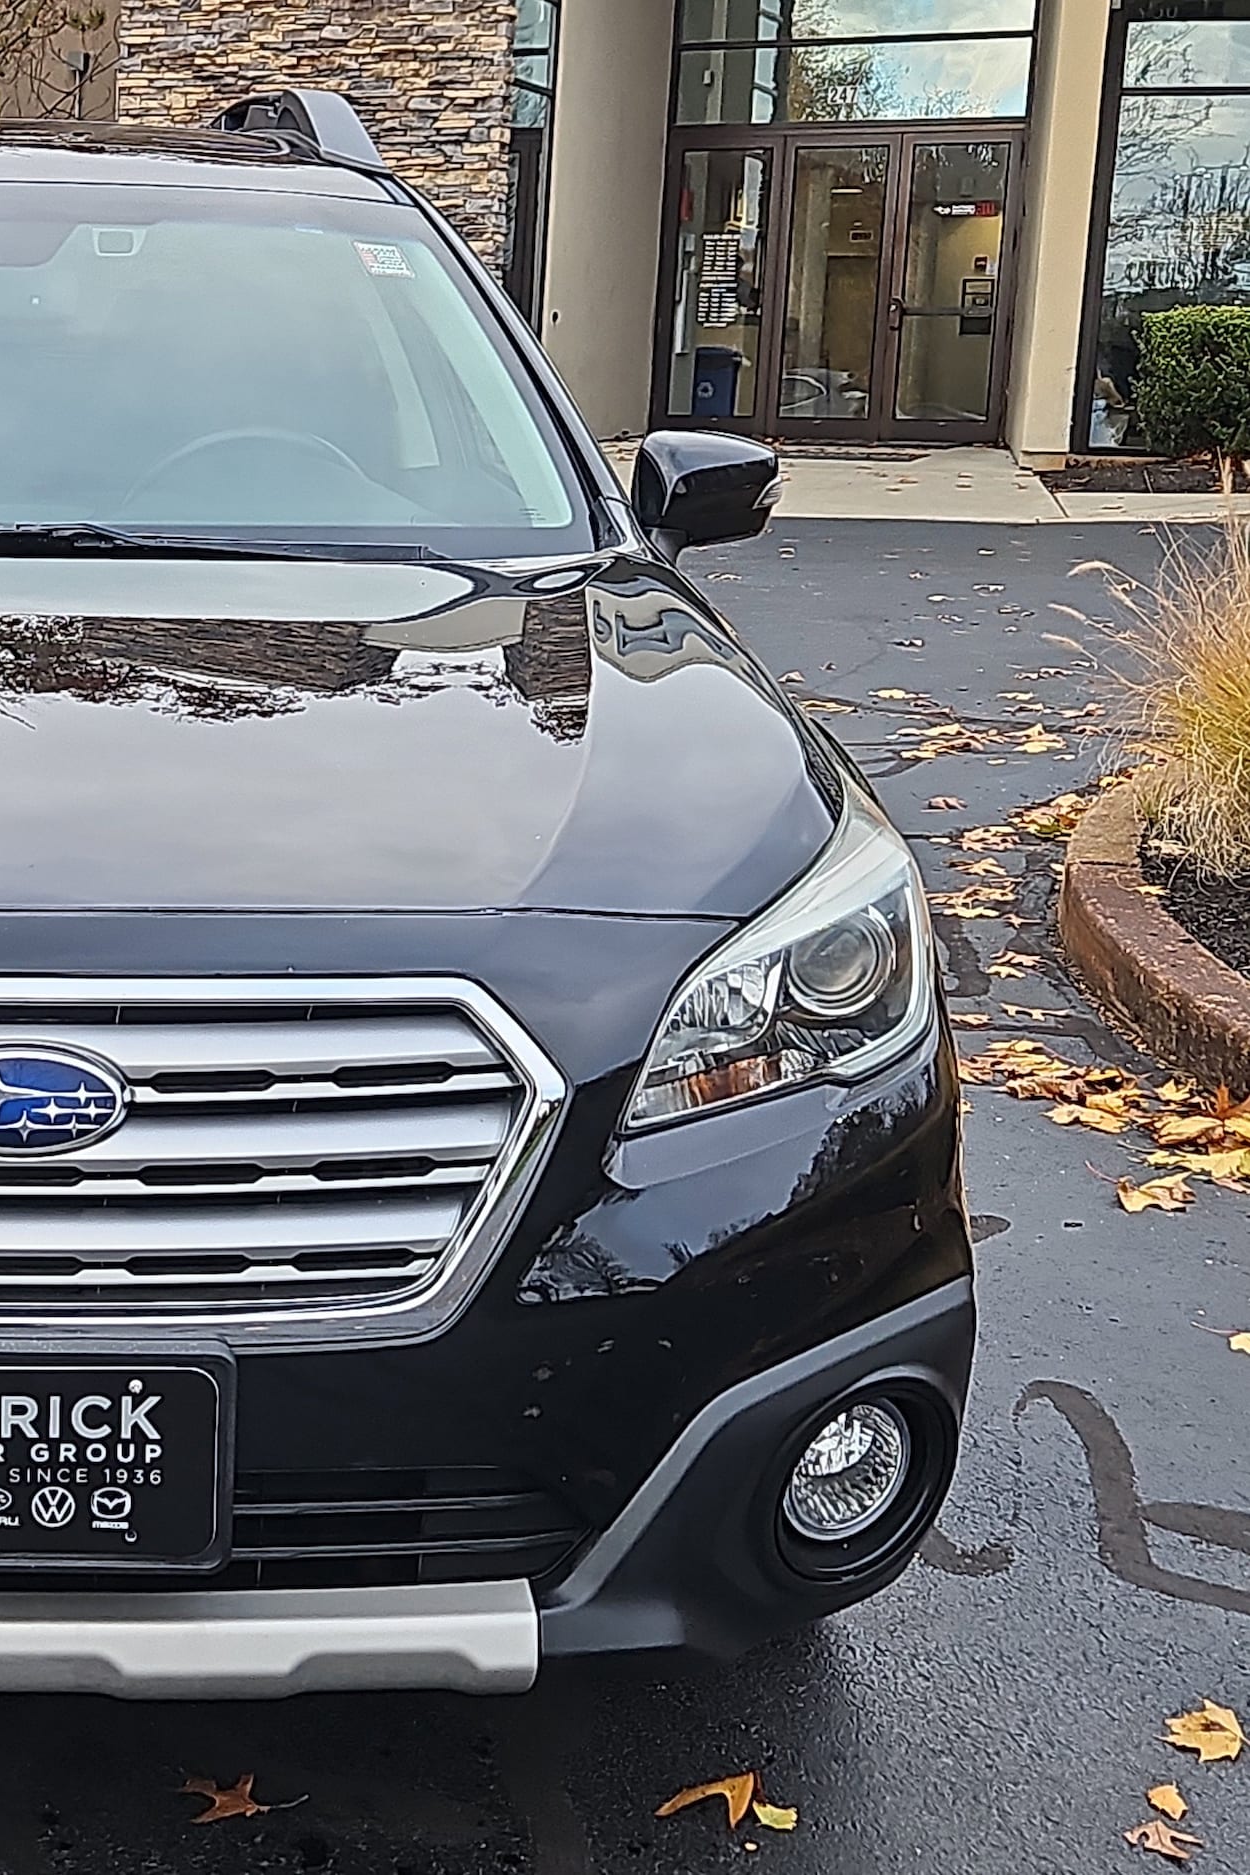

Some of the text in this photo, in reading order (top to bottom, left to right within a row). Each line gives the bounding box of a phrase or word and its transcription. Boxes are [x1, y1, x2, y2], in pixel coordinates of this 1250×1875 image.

[830, 86, 857, 103] 247
[30, 1443, 162, 1464] GROUP
[9, 1468, 88, 1484] SINCE
[104, 1468, 162, 1485] 1936
